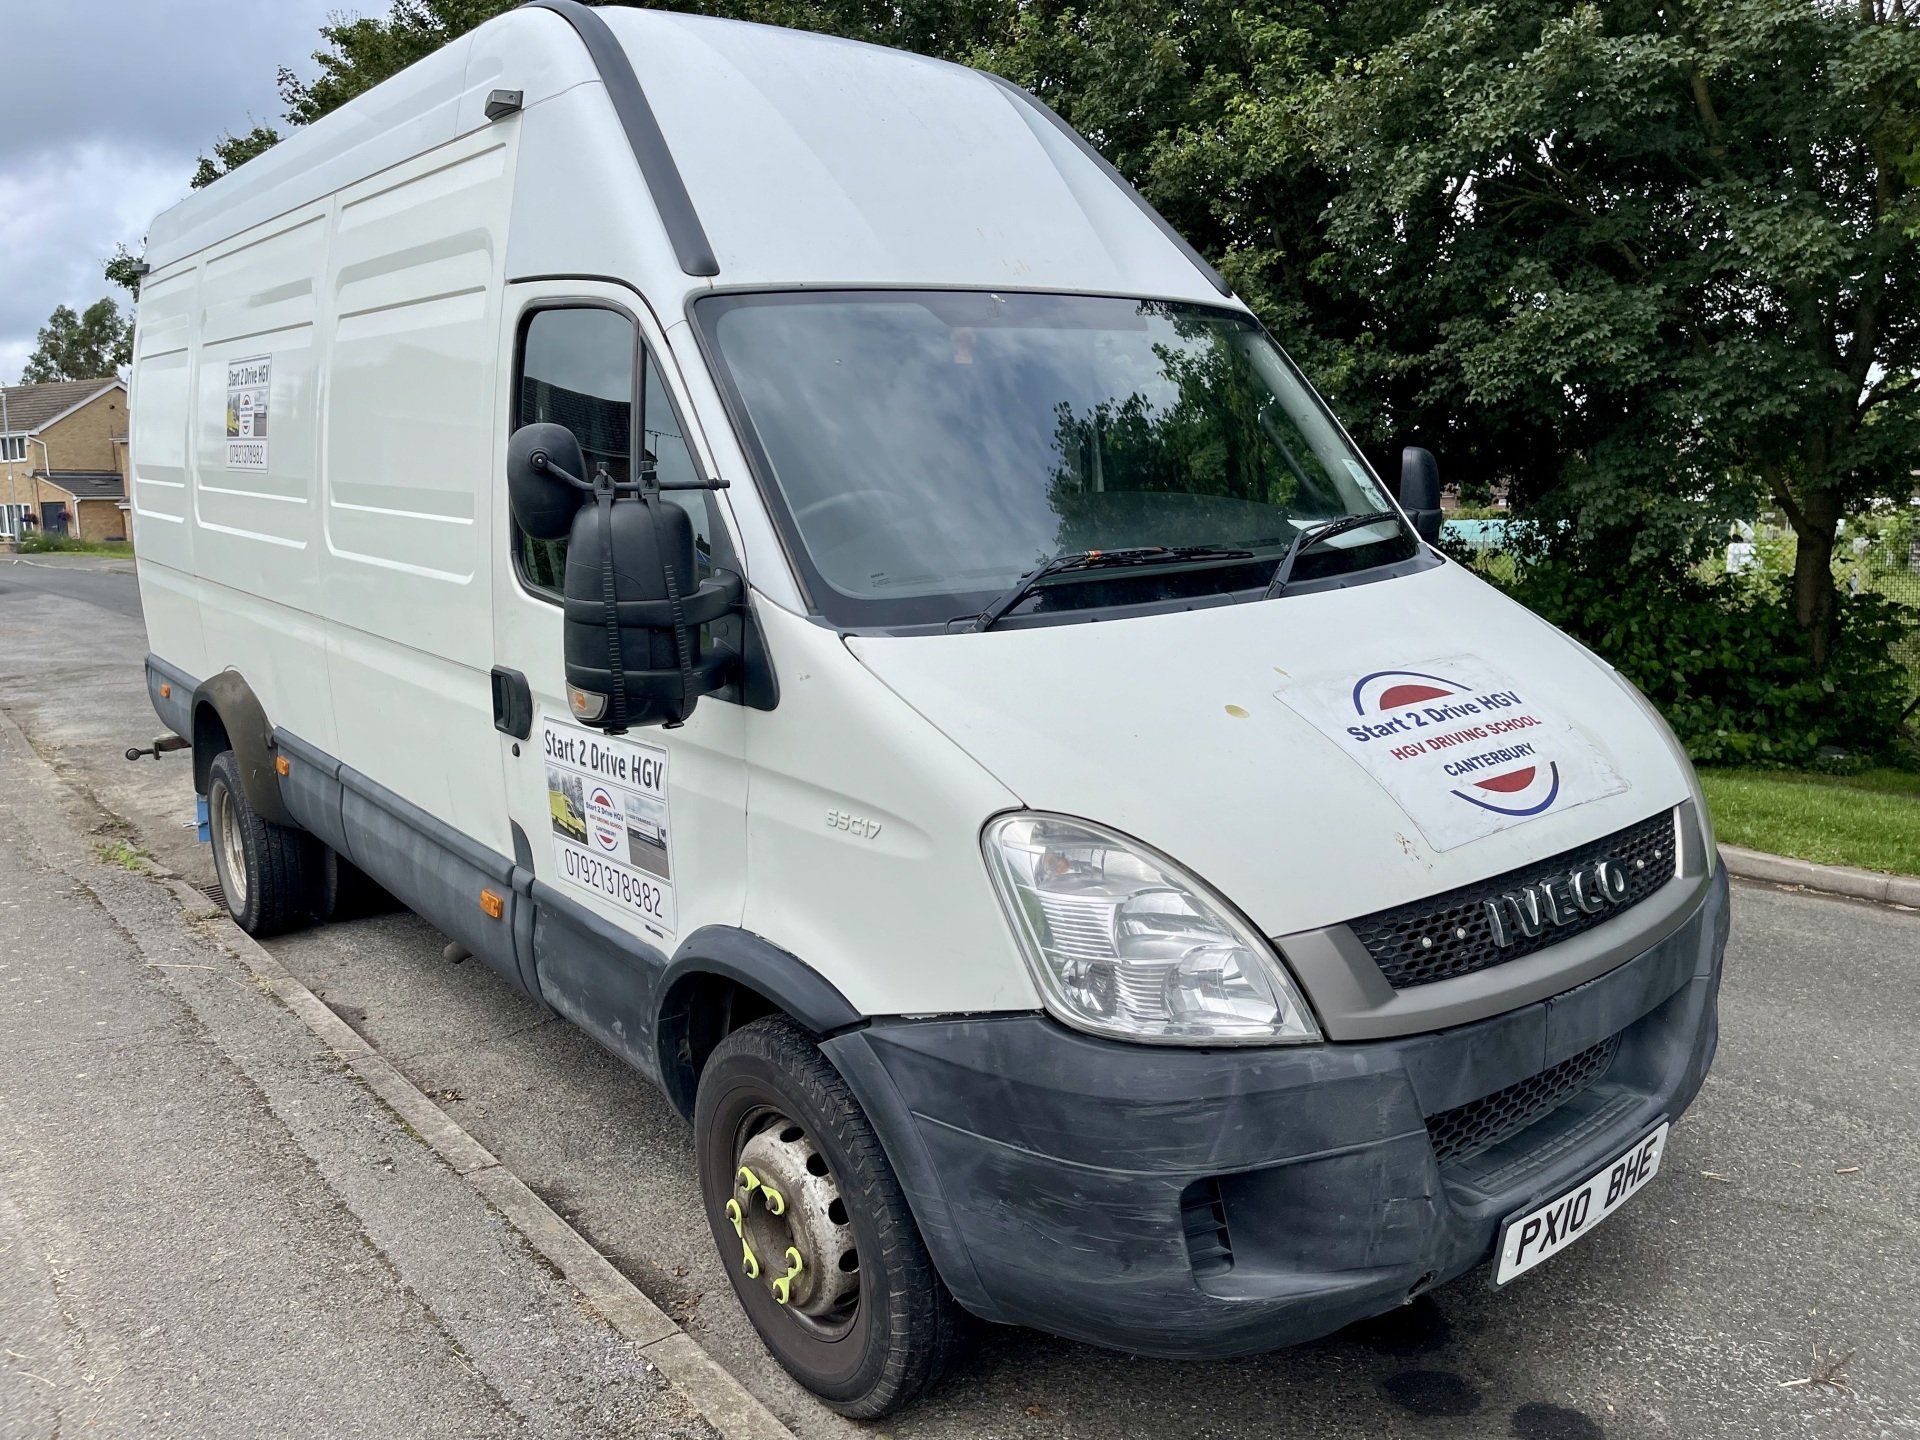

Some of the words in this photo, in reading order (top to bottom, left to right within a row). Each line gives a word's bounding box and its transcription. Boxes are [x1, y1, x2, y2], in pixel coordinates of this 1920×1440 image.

[229, 369, 240, 386] Start
[240, 368, 244, 385] 2
[245, 367, 257, 384] Drive
[258, 364, 269, 383] HGV
[1346, 715, 1412, 742] Start
[1405, 711, 1429, 728] 2
[1422, 702, 1482, 723] Drive
[1475, 690, 1523, 711] HGV
[1389, 741, 1427, 761] HGV
[1425, 726, 1488, 751] DRIVING
[1486, 714, 1542, 736] SCHOOL
[545, 729, 575, 764] Start
[579, 739, 587, 767] 2
[591, 743, 626, 780] Drive
[631, 754, 664, 792] HGV
[1443, 742, 1537, 777] CANTERBURY
[564, 848, 663, 919] 07921378982
[1483, 857, 1633, 948] IVECO
[1515, 1187, 1592, 1267] PX10
[1603, 1135, 1658, 1210] BHE
